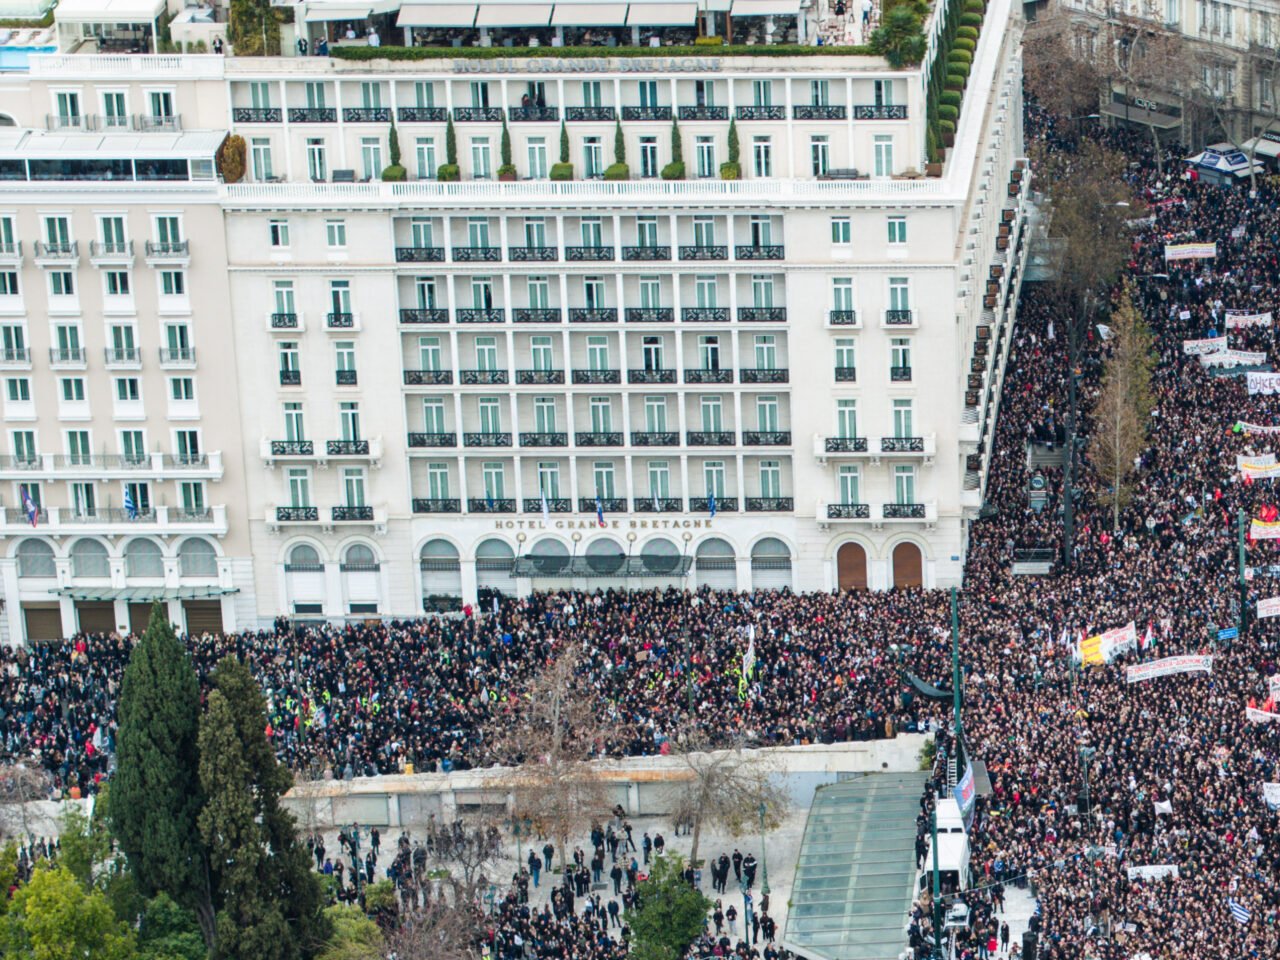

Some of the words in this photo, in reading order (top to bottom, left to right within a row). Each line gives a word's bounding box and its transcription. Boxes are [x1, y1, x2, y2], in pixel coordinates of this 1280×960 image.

[495, 520, 546, 529] HOTEL
[555, 520, 619, 529] GRANDE
[629, 519, 713, 529] BRETAGNE
